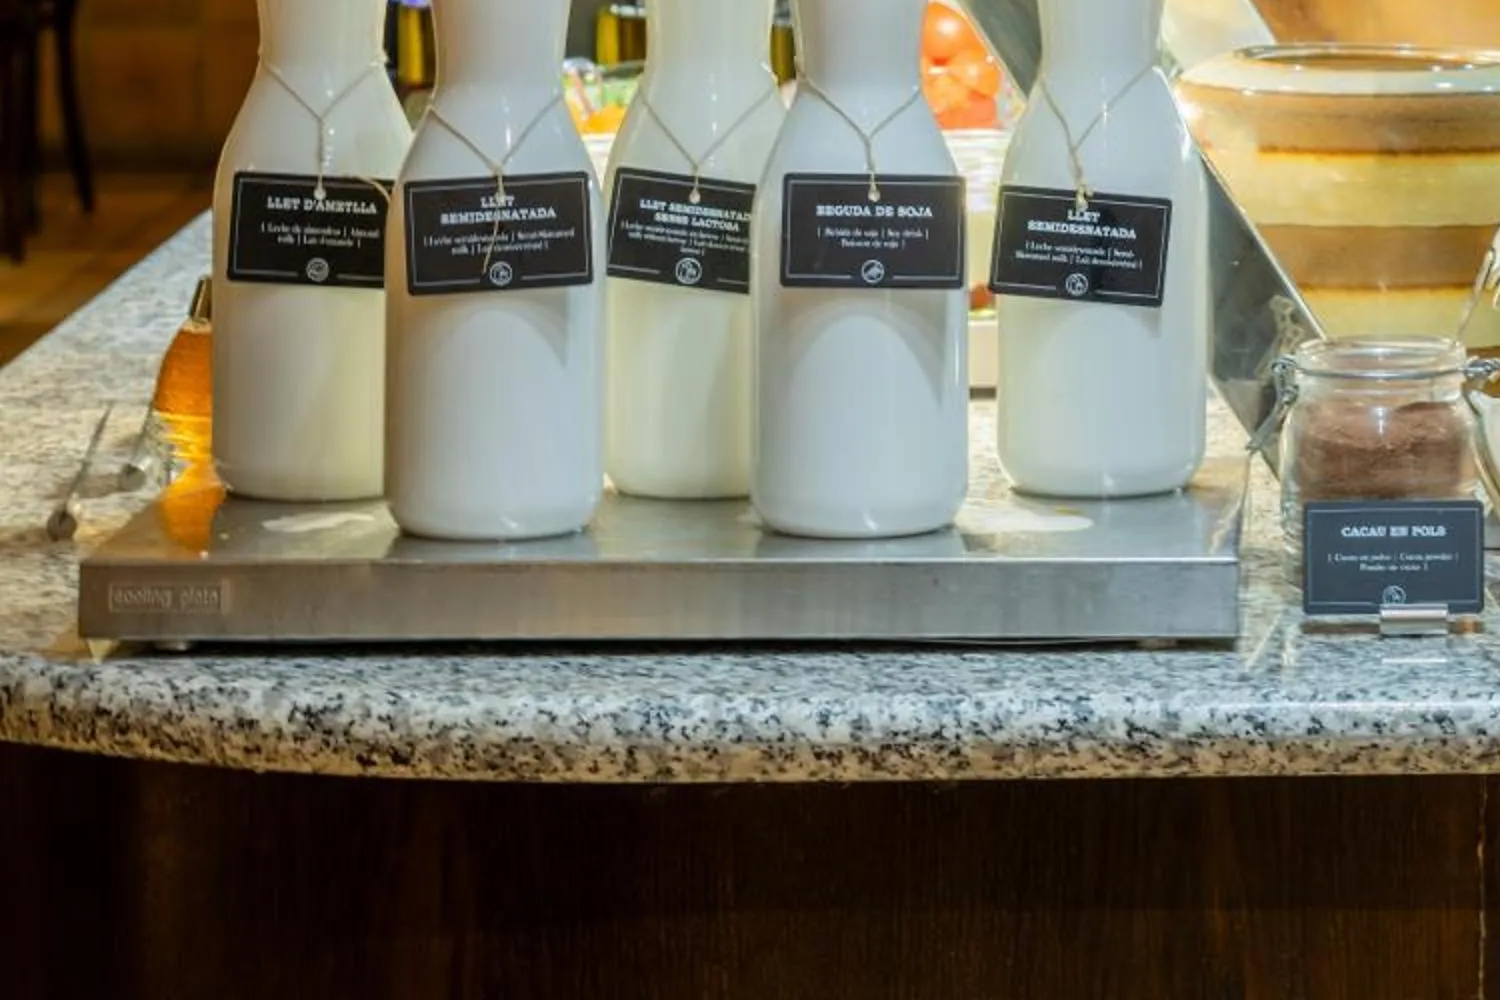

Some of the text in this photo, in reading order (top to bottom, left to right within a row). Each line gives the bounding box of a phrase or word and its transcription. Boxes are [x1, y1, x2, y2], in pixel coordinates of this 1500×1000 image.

[267, 196, 377, 214] LLET D'AMETLLA
[639, 198, 667, 211] LLET
[816, 205, 933, 217] BEGUDA DE SOJA
[1067, 209, 1101, 222] LLET
[692, 217, 739, 232] LACTOSA
[1027, 220, 1137, 239] SEMIDESNATADA
[1341, 525, 1447, 537] CACAU EN POLS
